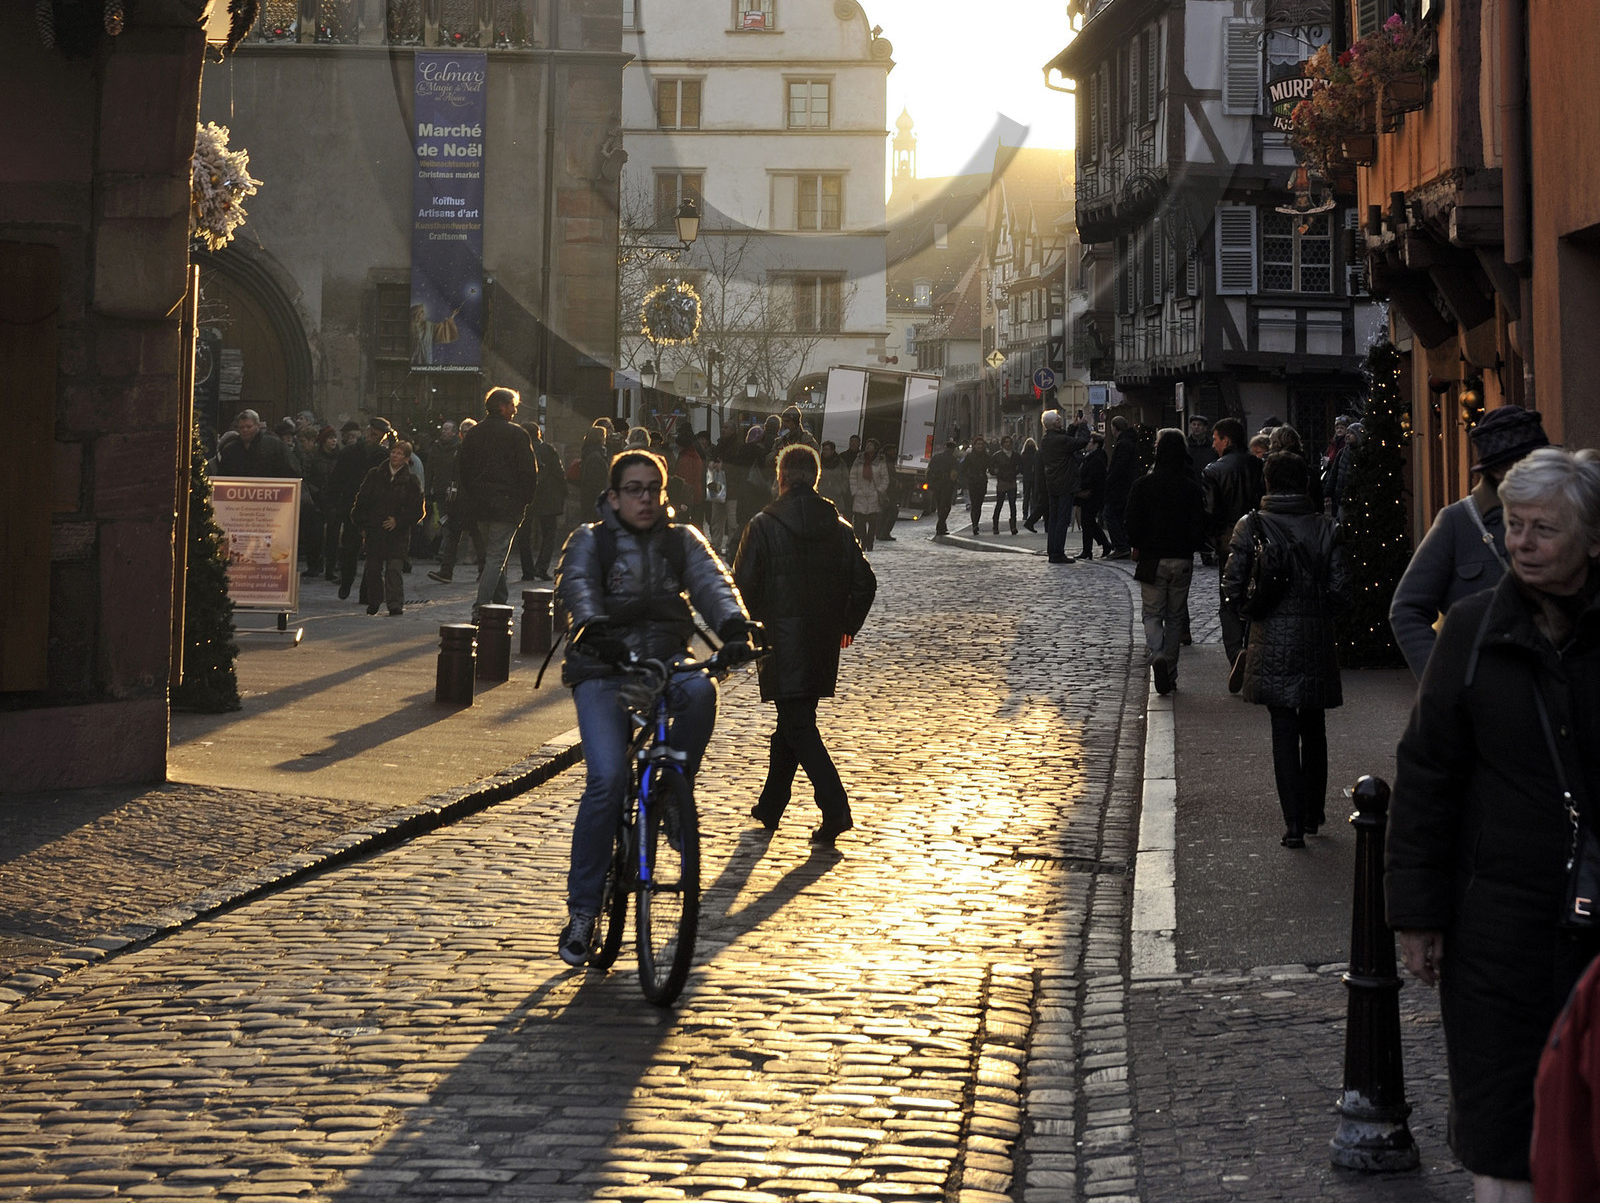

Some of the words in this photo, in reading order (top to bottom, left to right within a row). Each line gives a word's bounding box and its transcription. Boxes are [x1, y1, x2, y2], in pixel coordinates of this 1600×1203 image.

[418, 61, 486, 81] Colmar
[461, 81, 484, 92] Noël
[418, 123, 482, 137] Marché
[417, 143, 438, 157] de
[443, 143, 482, 157] Noël
[419, 159, 480, 168] Weihnachtsmarkt
[418, 171, 454, 179] Christmas
[455, 171, 480, 179] market
[418, 208, 456, 218] Artisans
[457, 209, 479, 218] d'art
[415, 221, 481, 230] Kunsthandwerker
[428, 232, 468, 240] Craftsmen
[411, 364, 480, 372] www.noel-colmar.com
[226, 488, 281, 500] OUVERT
